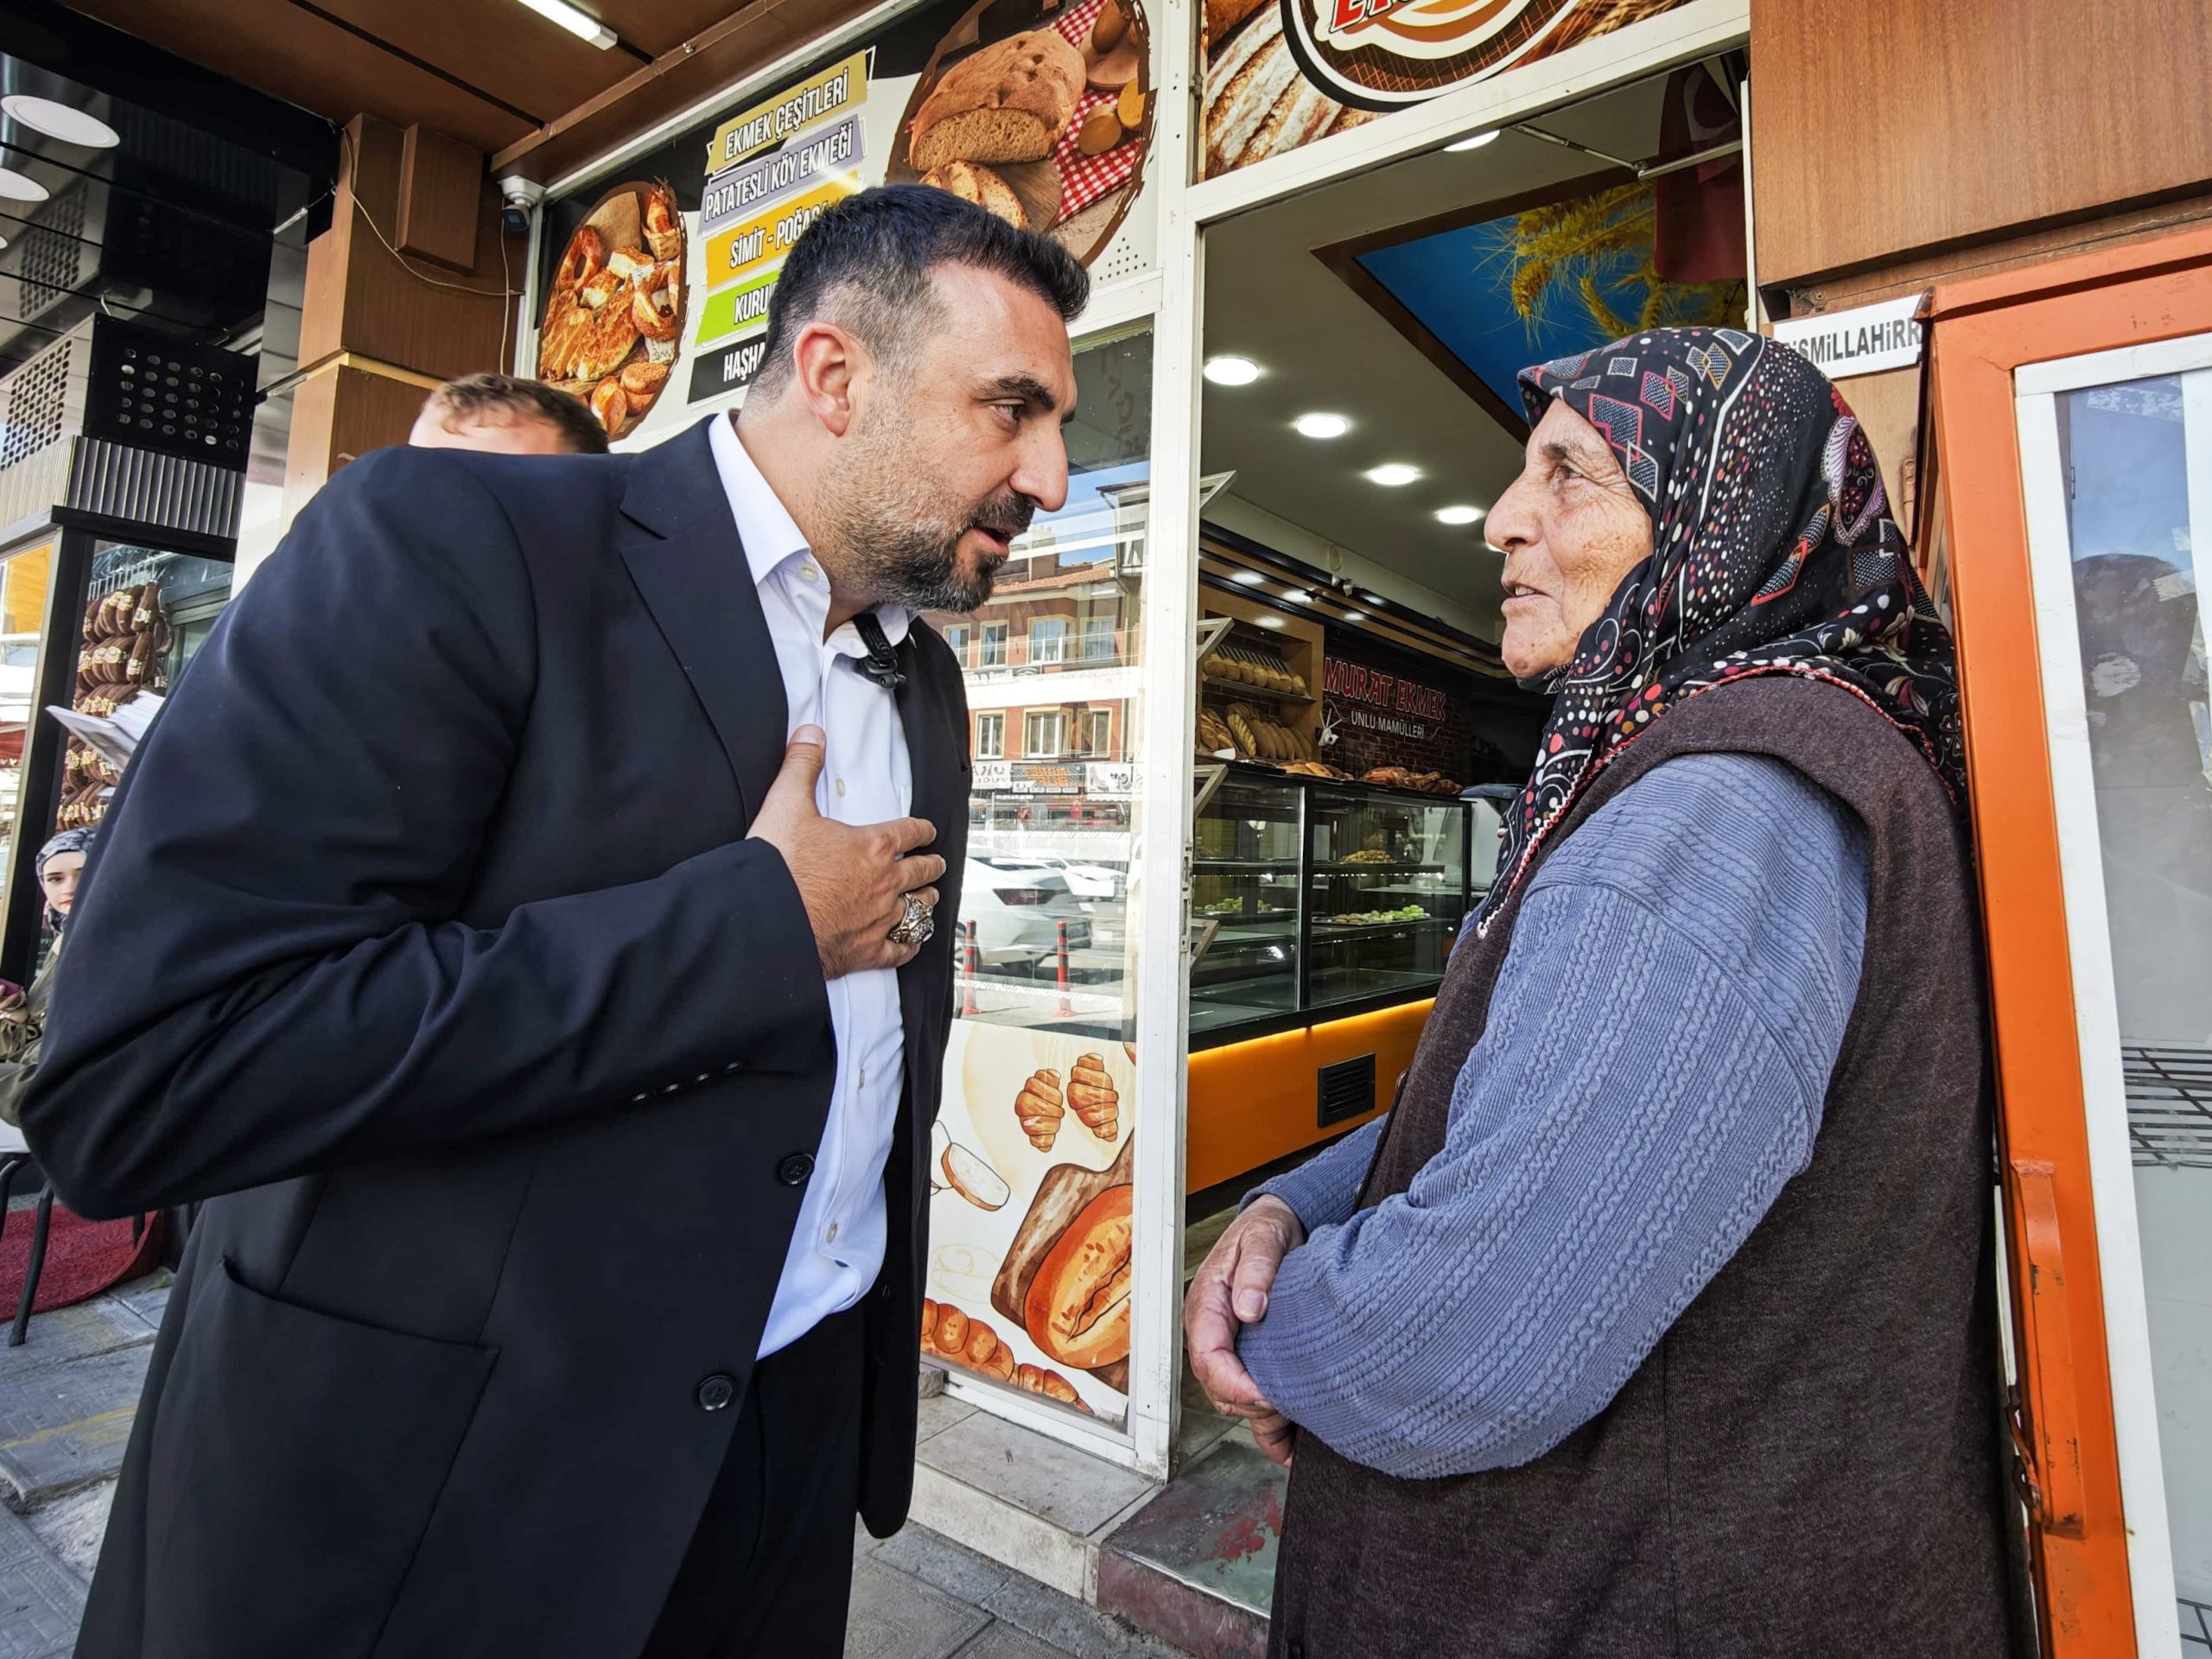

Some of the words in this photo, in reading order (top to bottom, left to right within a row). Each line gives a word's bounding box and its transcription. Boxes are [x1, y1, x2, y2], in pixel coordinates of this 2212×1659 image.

[725, 111, 773, 162] EKMEK
[775, 67, 849, 139] ÇEŞİTLERİ
[705, 162, 770, 221] PATATESLİ
[770, 151, 798, 193] KÖY
[800, 121, 853, 179] EKMEĞİ
[730, 226, 766, 269] SİMİT
[1322, 657, 1393, 707] MURAT
[1396, 678, 1446, 721] EKMEK
[1351, 710, 1376, 729] UNLU
[1378, 717, 1425, 741] MAMÜLLERİ
